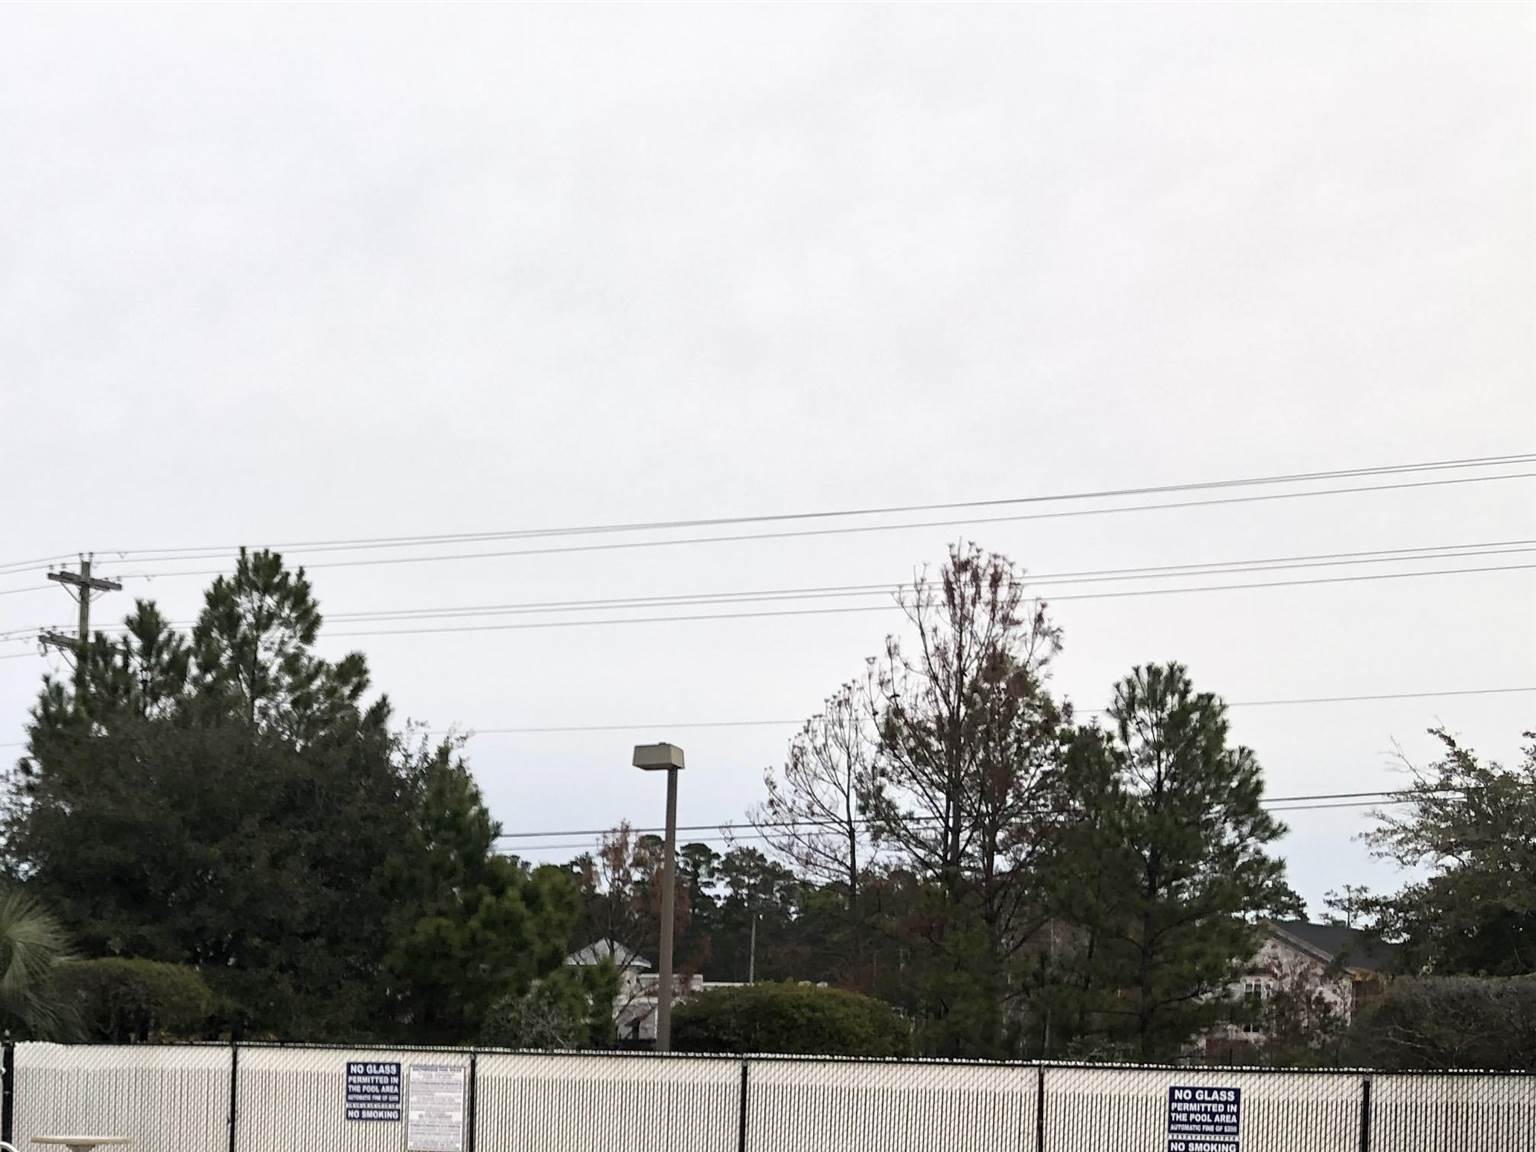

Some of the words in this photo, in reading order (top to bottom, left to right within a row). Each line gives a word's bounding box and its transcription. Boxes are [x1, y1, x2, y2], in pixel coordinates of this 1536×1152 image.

[350, 1064, 364, 1074] NO
[366, 1064, 397, 1075] GLASS
[348, 1076, 389, 1084] PERMITTED
[390, 1076, 399, 1084] IN
[348, 1085, 361, 1093] THE
[362, 1085, 380, 1093] POOL
[381, 1085, 399, 1093] AREA
[1174, 1089, 1192, 1100] NO
[1195, 1090, 1235, 1102] GLASS
[1171, 1102, 1224, 1112] PERMITTED
[1227, 1104, 1237, 1113] IN
[348, 1110, 360, 1119] NO
[361, 1110, 399, 1119] SMOKING
[1170, 1112, 1188, 1122] THE
[1189, 1113, 1212, 1122] POOL
[1214, 1114, 1237, 1123] AREA
[1170, 1142, 1185, 1152] NO
[1188, 1142, 1237, 1152] SMOKING
